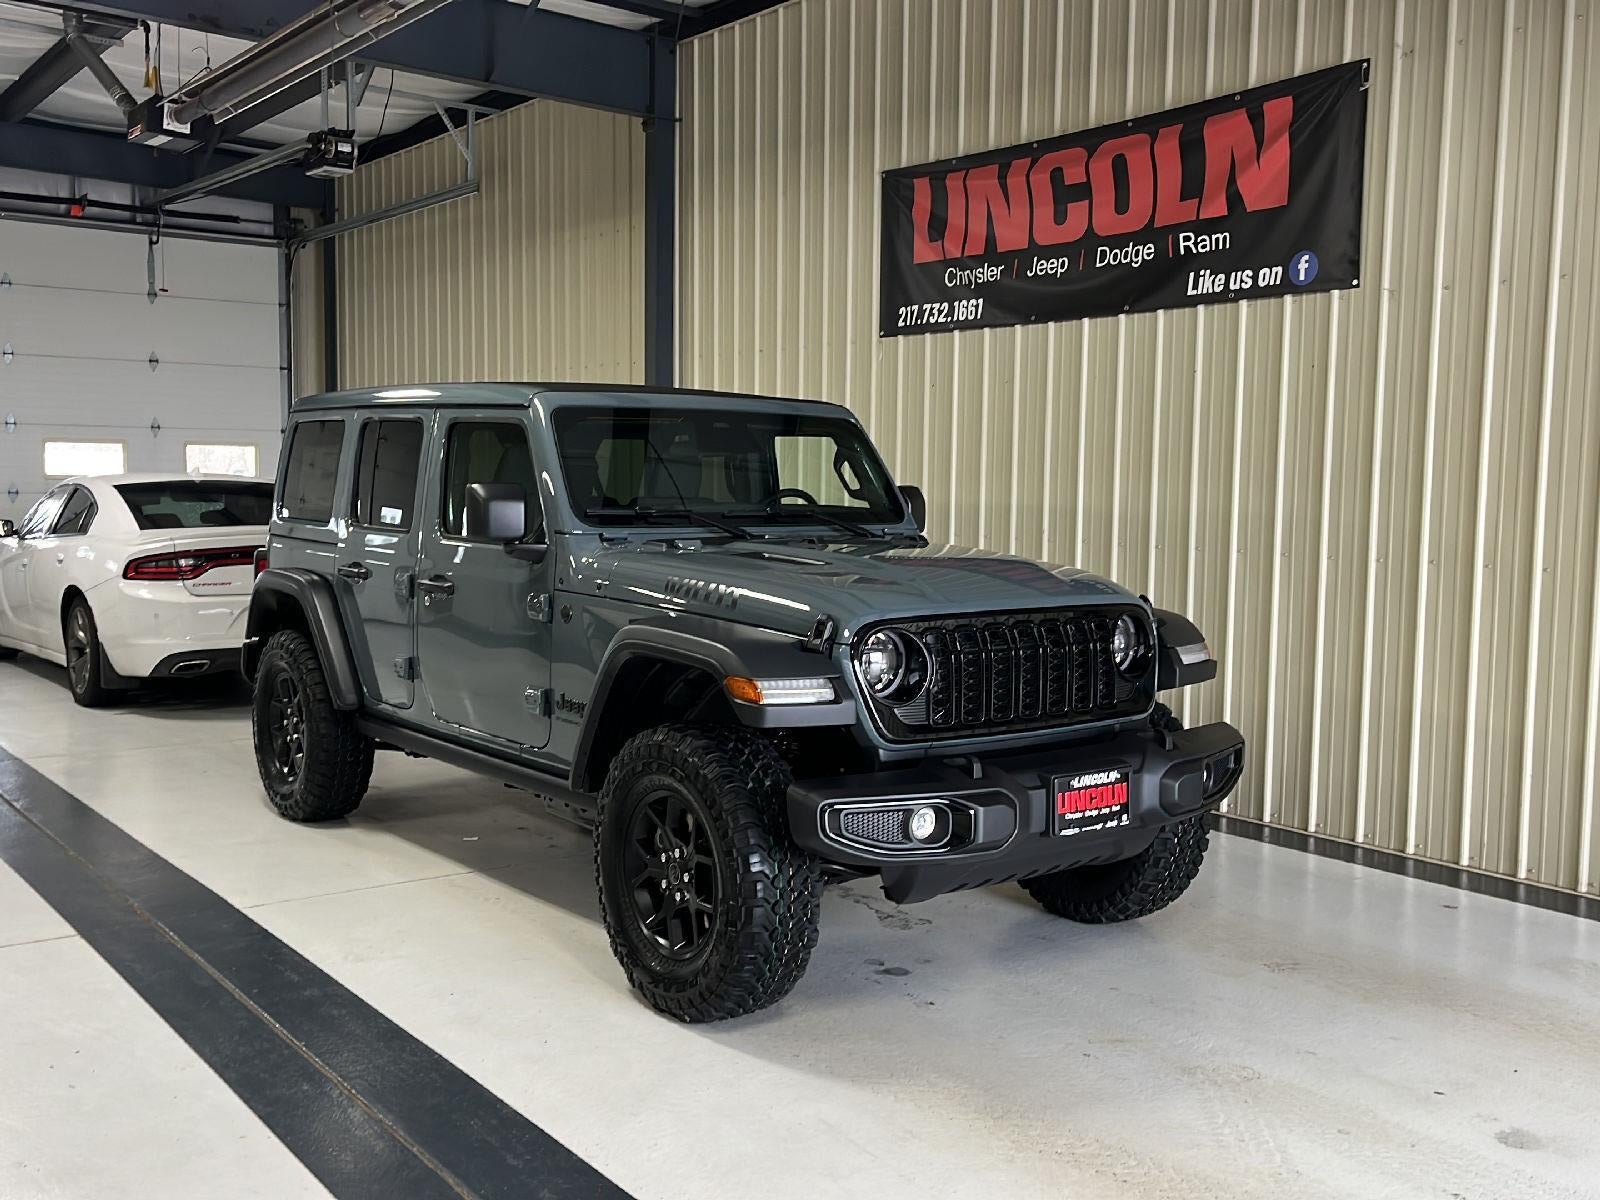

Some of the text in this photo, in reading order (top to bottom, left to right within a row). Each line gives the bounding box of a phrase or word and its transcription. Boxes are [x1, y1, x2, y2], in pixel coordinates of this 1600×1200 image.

[912, 96, 1294, 265] LINCOLN
[944, 231, 1230, 289] Chrysler Jeep Dodge Ram
[1187, 269, 1225, 296] Like
[1229, 269, 1253, 290] us
[1258, 265, 1283, 288] on
[897, 298, 984, 327] 217.732.1661
[1057, 782, 1128, 814] LINCOLN
